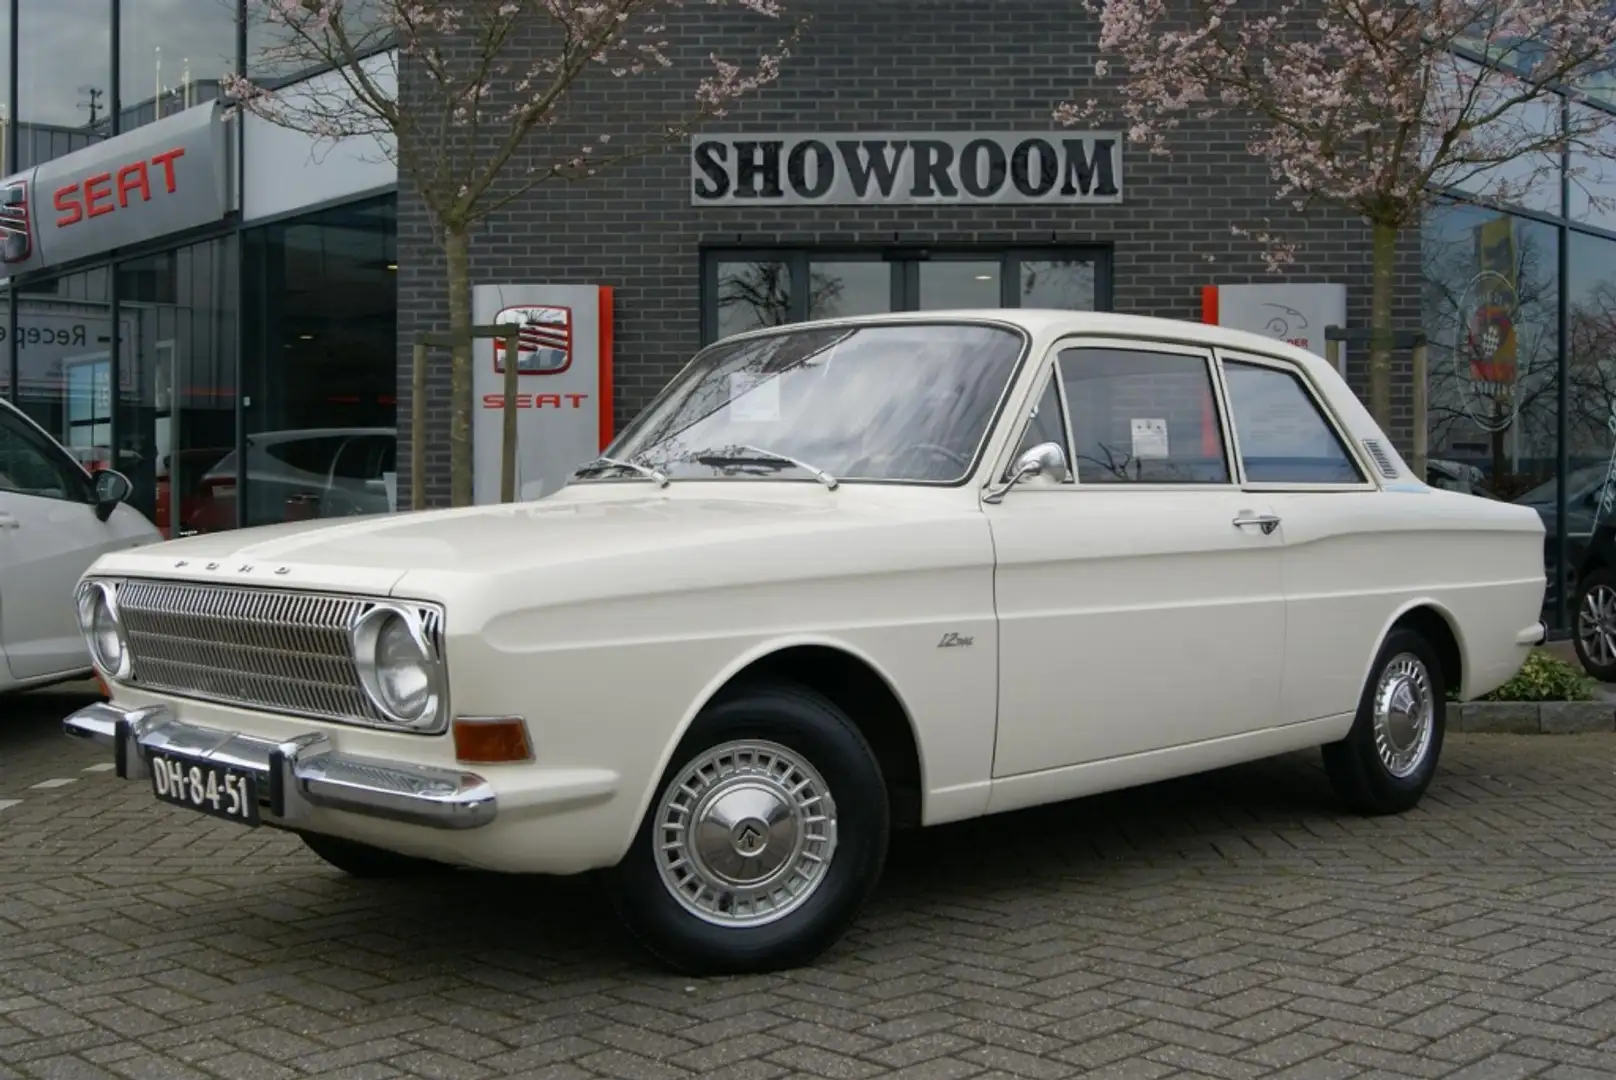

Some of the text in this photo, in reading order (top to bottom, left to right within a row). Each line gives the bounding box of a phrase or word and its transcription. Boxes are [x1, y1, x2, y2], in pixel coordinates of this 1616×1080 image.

[53, 147, 185, 228] SEAT
[694, 138, 1119, 198] SHOWROOM
[483, 394, 588, 408] SEAT
[153, 757, 249, 818] DH-84-51
